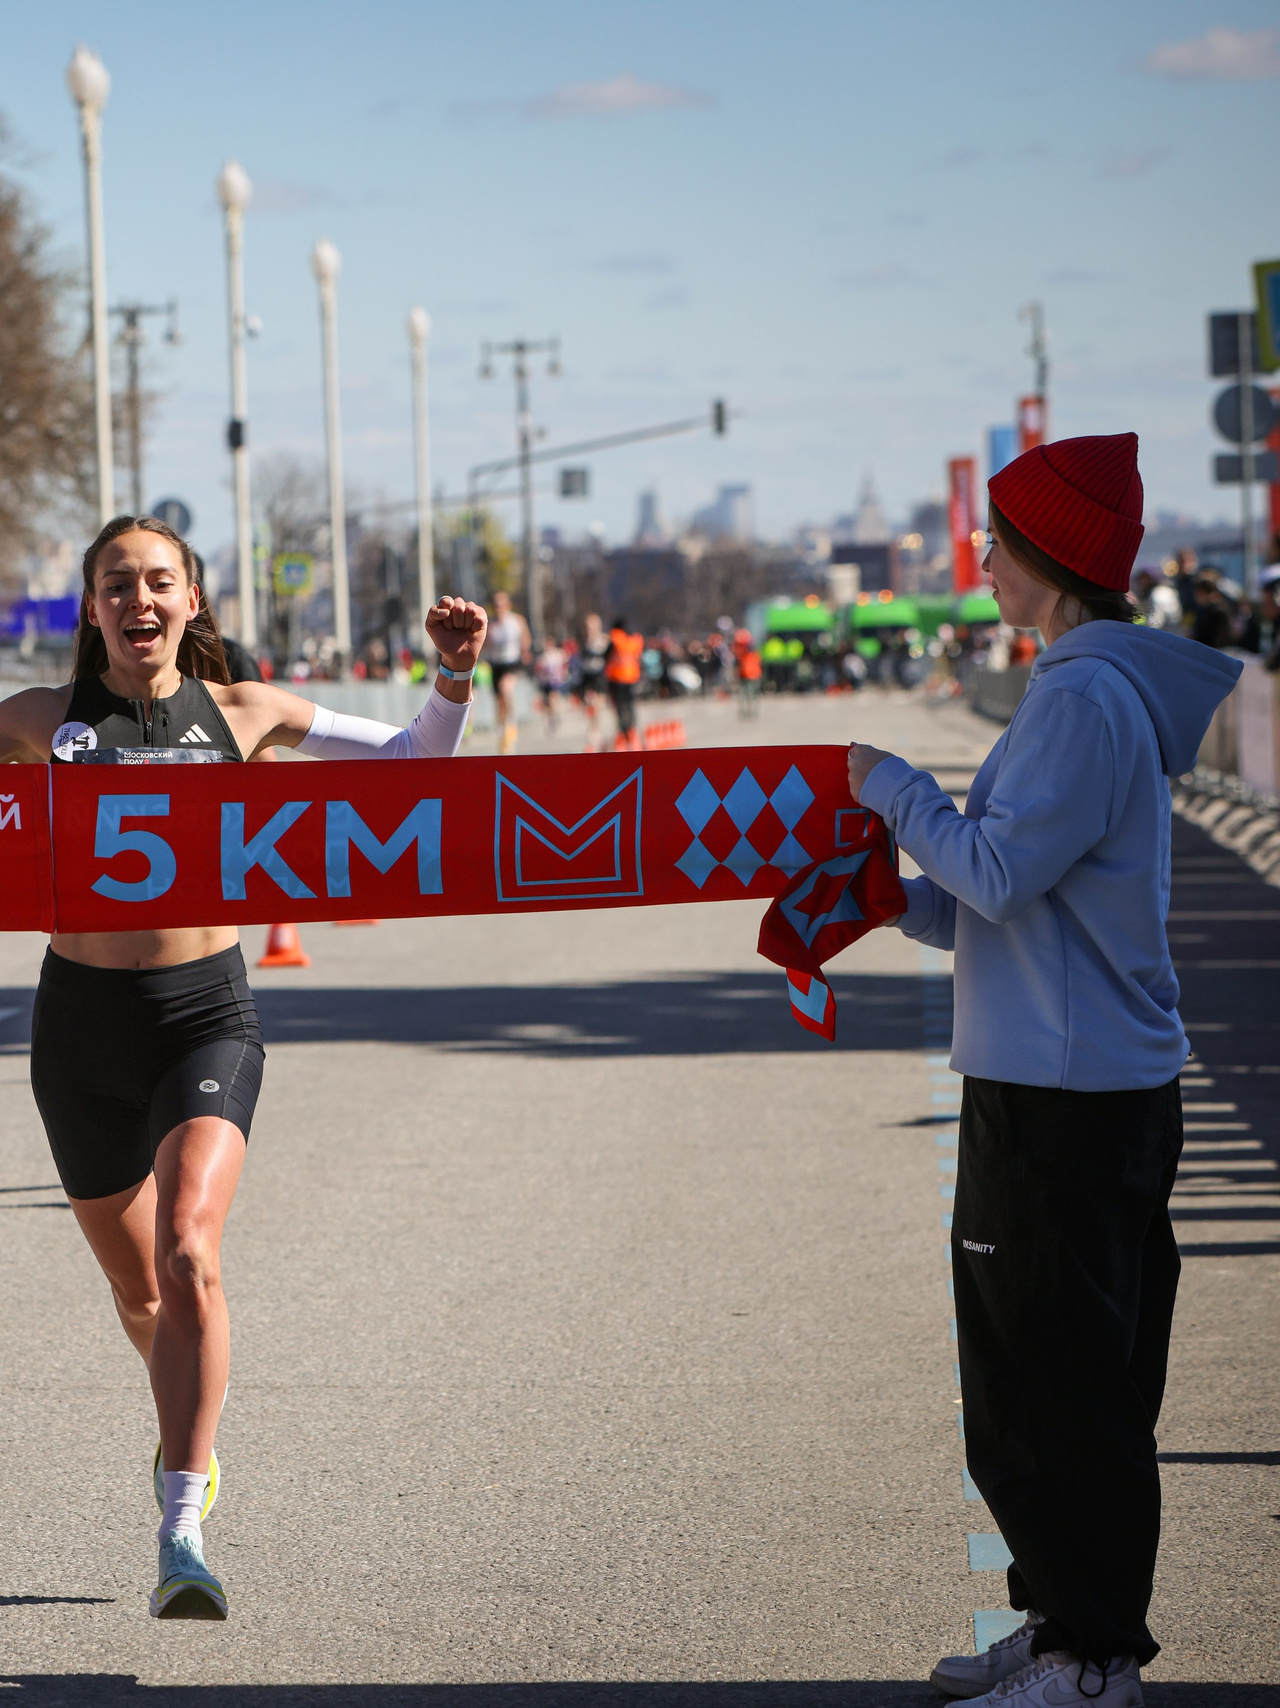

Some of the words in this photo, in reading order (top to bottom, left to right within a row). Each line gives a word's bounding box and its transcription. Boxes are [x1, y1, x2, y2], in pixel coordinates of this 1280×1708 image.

[123, 751, 173, 759] МОСКОВСКИЙ
[90, 794, 177, 902] 5
[220, 798, 444, 900] КМ
[962, 1238, 996, 1254] INSANITY
